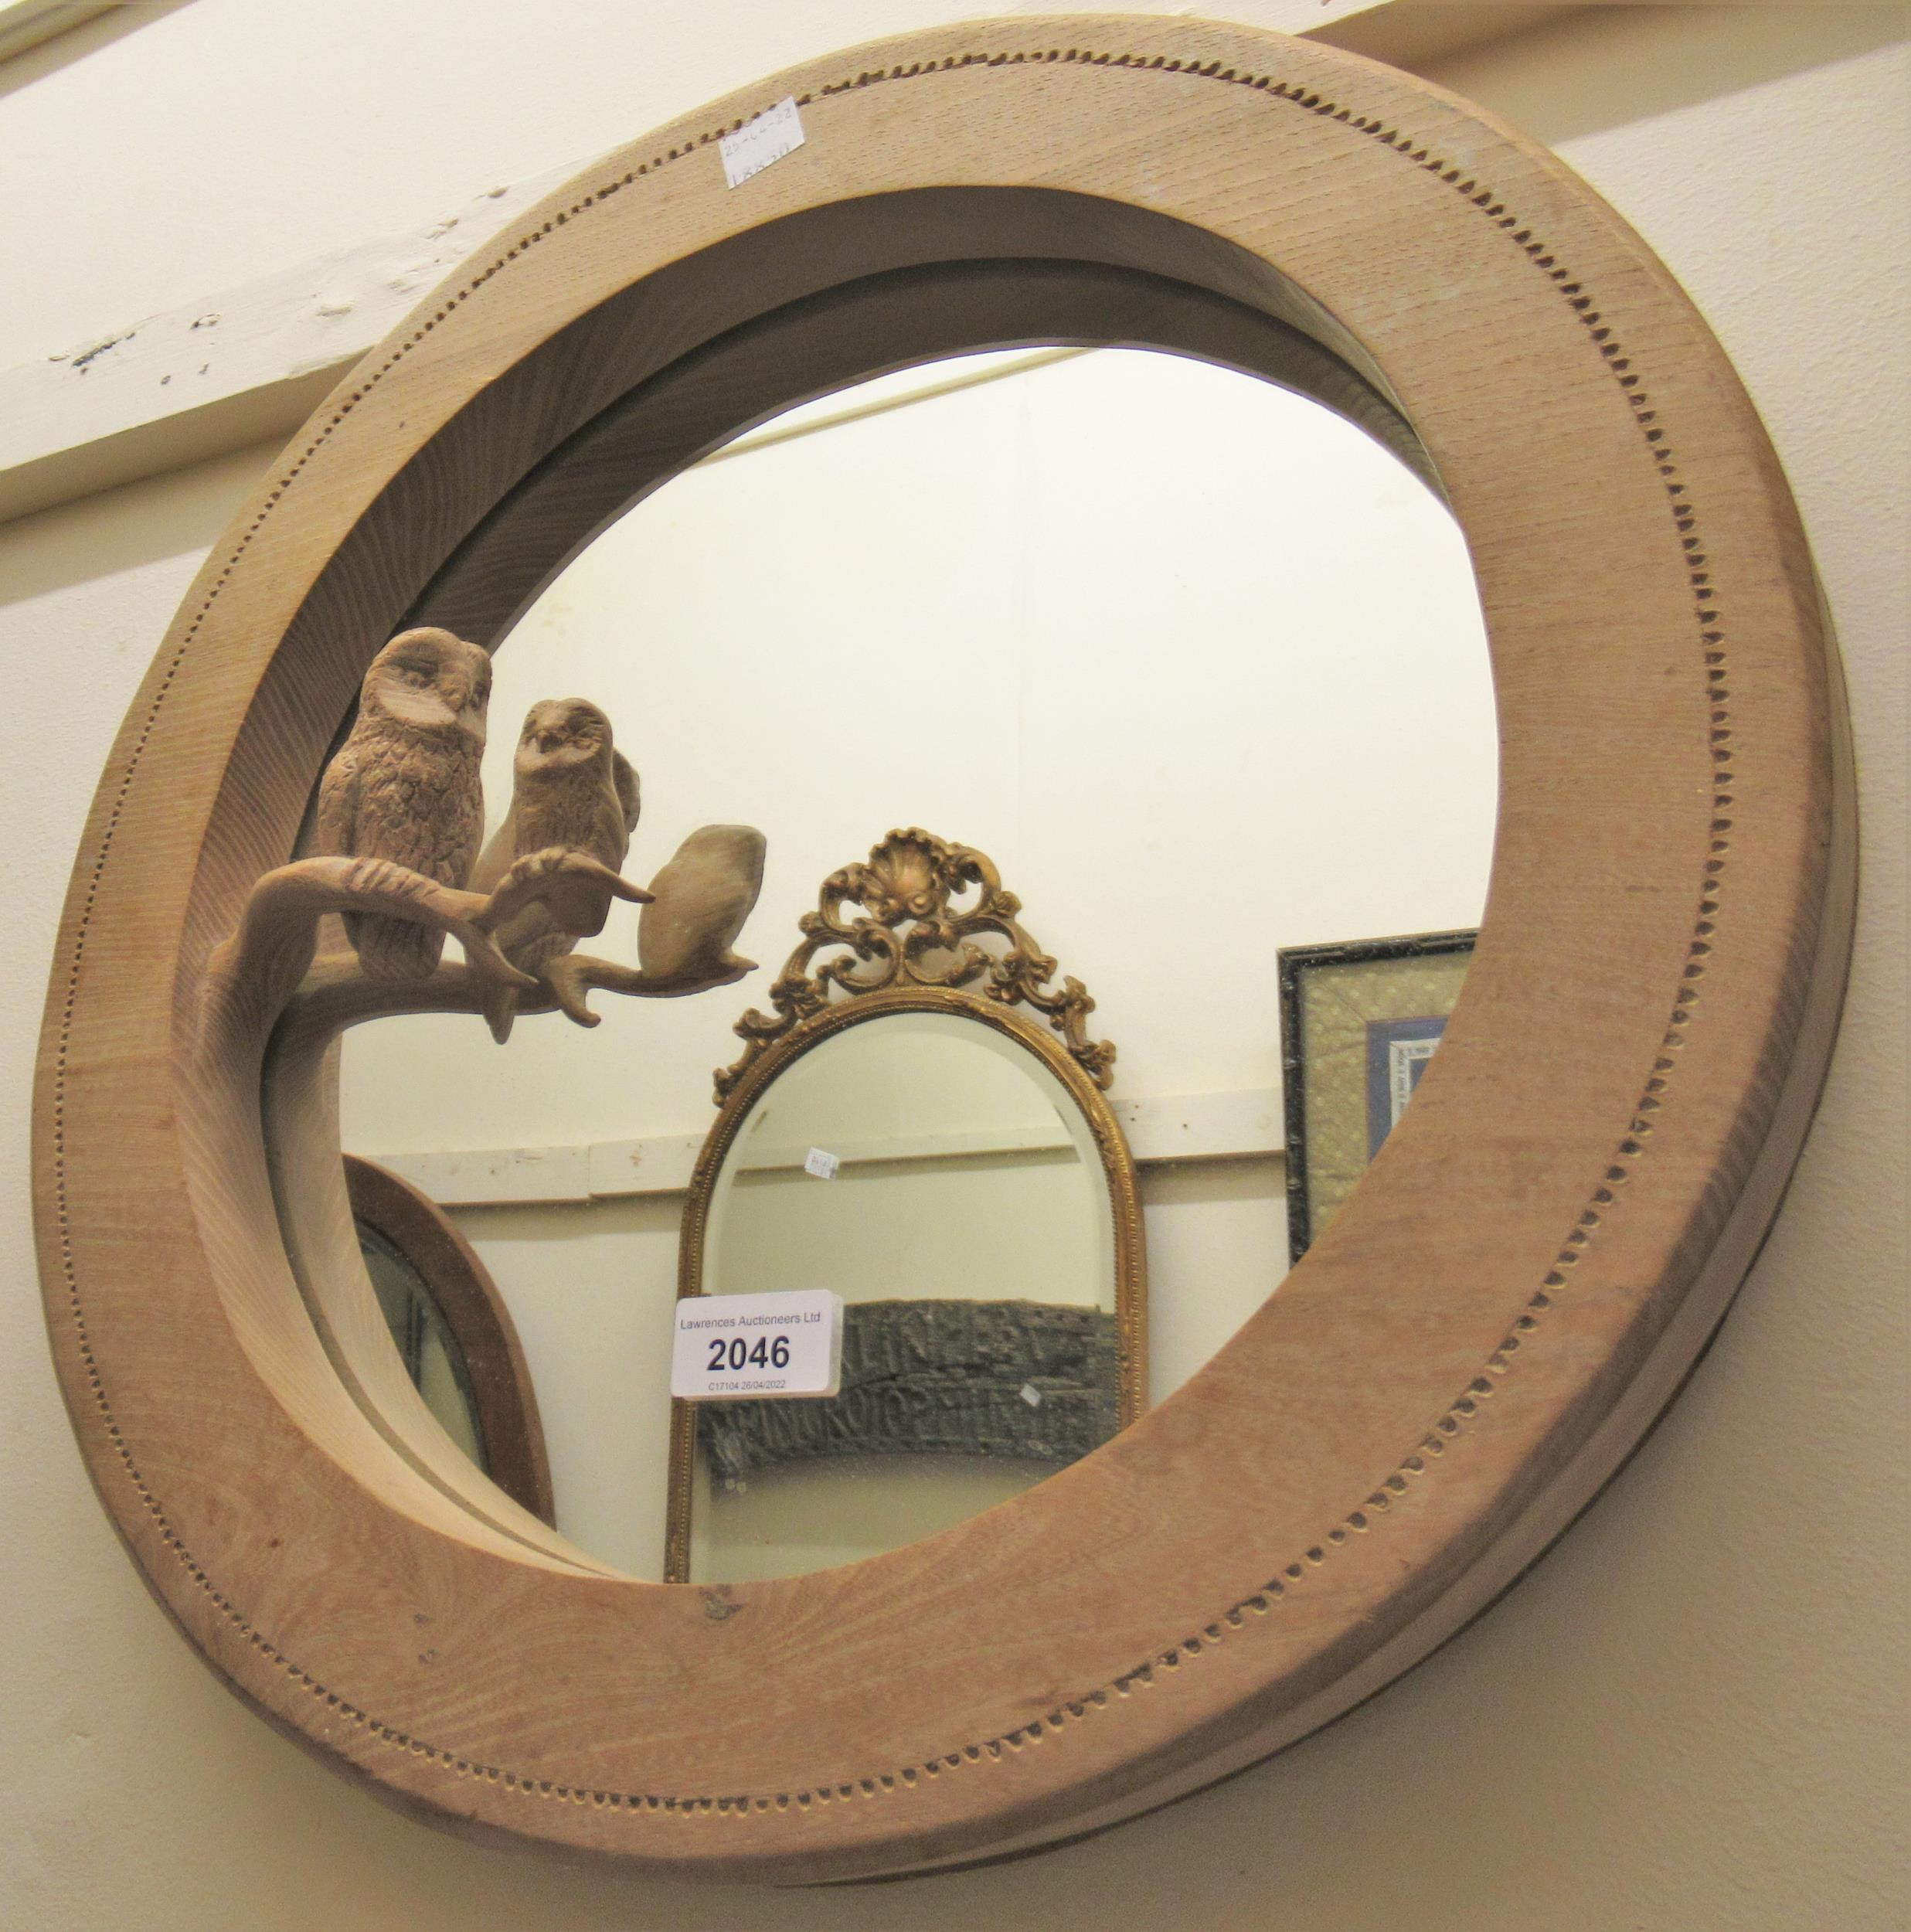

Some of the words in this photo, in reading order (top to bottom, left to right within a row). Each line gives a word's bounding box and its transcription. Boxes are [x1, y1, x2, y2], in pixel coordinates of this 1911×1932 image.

[680, 1318, 736, 1330] Lawrences
[737, 1312, 801, 1327] Auctioneers
[804, 1311, 821, 1323] Ltd
[706, 1335, 790, 1372] 2046
[708, 1381, 740, 1391] C17104
[741, 1379, 787, 1390] 26/04/2022
